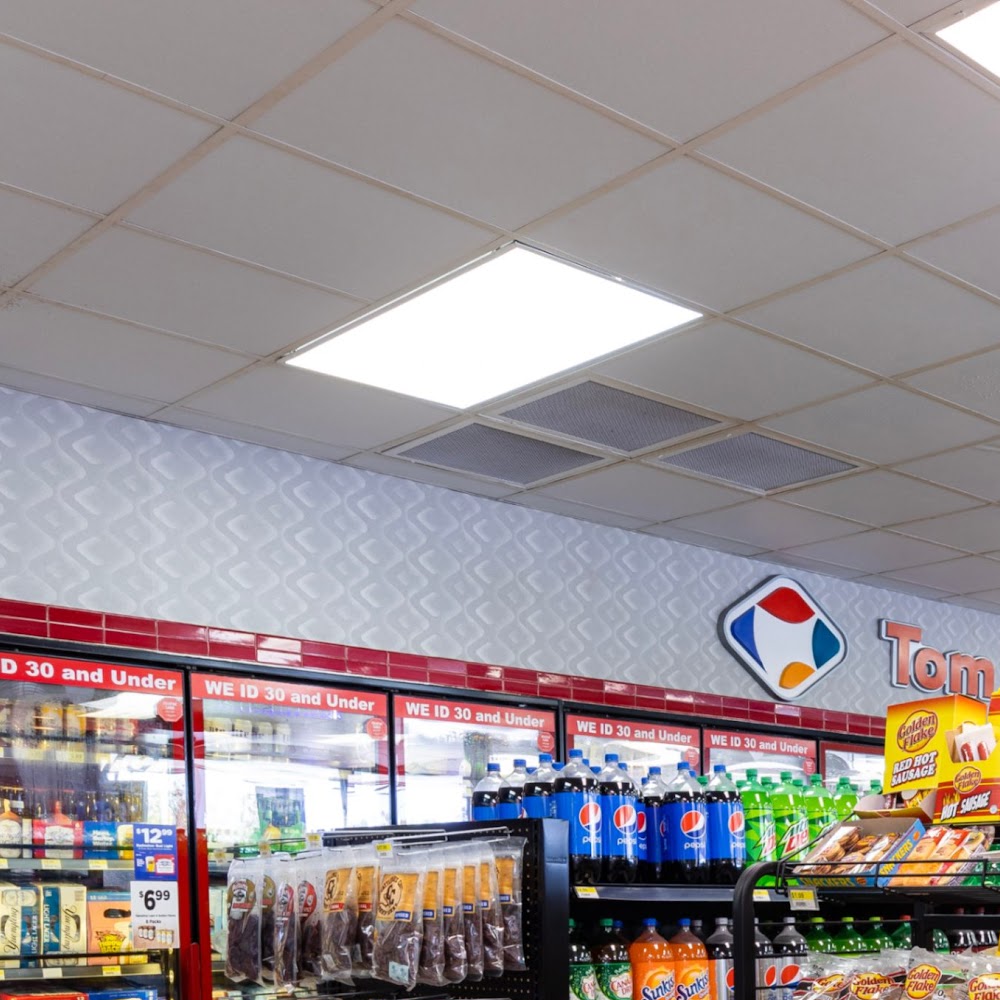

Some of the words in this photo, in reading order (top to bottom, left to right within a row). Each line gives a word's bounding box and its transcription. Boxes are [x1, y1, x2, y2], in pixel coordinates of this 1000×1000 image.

[881, 619, 995, 700] Tom
[26, 662, 54, 678] 30
[62, 667, 103, 683] and
[111, 669, 176, 691] Under
[205, 680, 234, 697] WE
[240, 683, 258, 699] ID
[264, 686, 286, 702] 30
[291, 690, 321, 706] and
[326, 694, 375, 712] Under
[405, 702, 430, 716] WE
[434, 705, 450, 719] ID
[454, 707, 471, 721] 30
[475, 709, 501, 724] and
[505, 712, 545, 728] Under
[899, 711, 937, 737] Golden
[576, 720, 598, 733] WE
[600, 722, 614, 735] ID
[616, 724, 631, 737] 30
[634, 727, 656, 740] and
[658, 729, 692, 744] Under
[710, 733, 728, 746] WE
[731, 735, 742, 747] ID
[743, 737, 757, 750] 30
[758, 739, 778, 752] and
[779, 741, 808, 755] Under
[902, 727, 936, 752] Flake
[893, 756, 912, 774] RED
[914, 751, 937, 768] HOT
[891, 765, 936, 787] SAUSAGE
[853, 973, 895, 986] Golden
[907, 967, 940, 981] Golden
[907, 978, 935, 994] Flake
